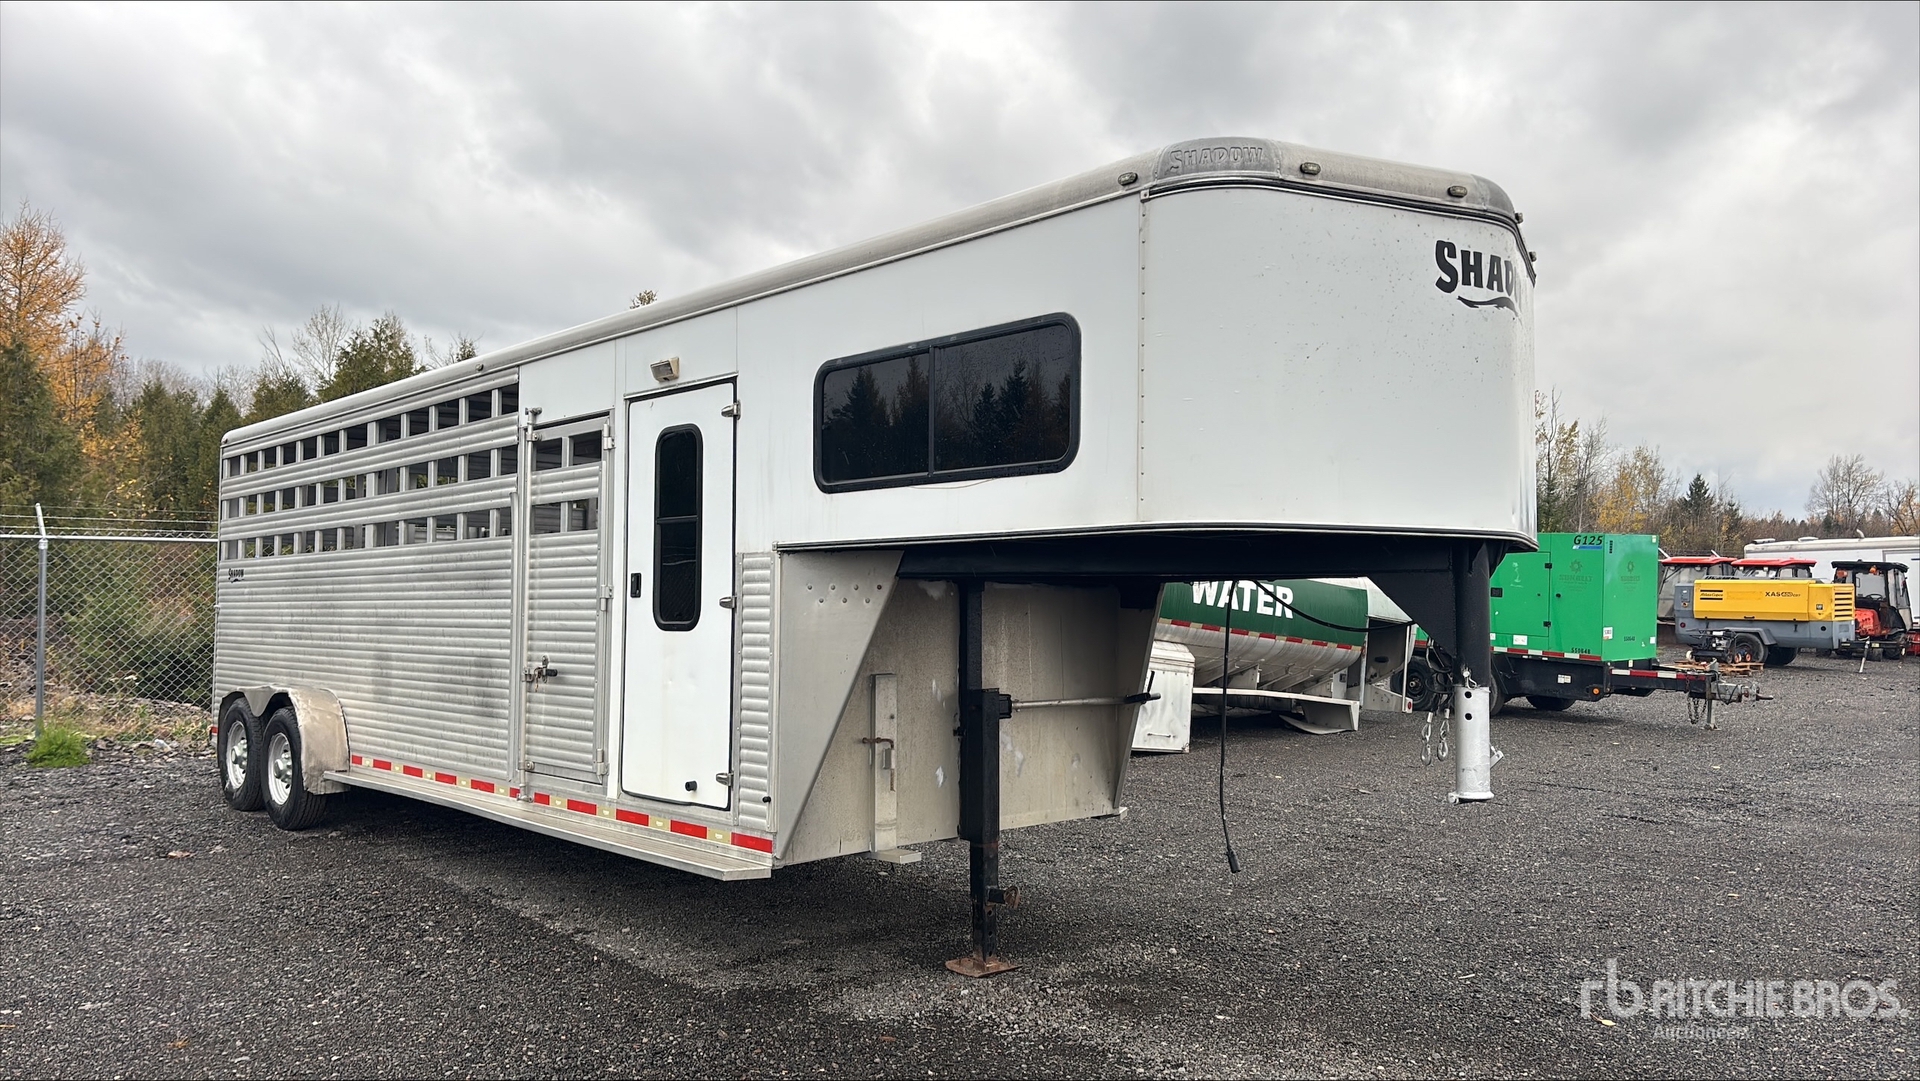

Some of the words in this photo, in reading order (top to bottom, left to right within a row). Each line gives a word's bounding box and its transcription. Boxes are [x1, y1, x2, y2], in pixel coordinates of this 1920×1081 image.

[1169, 146, 1263, 170] SHADOW
[1435, 240, 1518, 300] SHAD
[1573, 535, 1604, 546] G125
[1192, 580, 1294, 619] WATER
